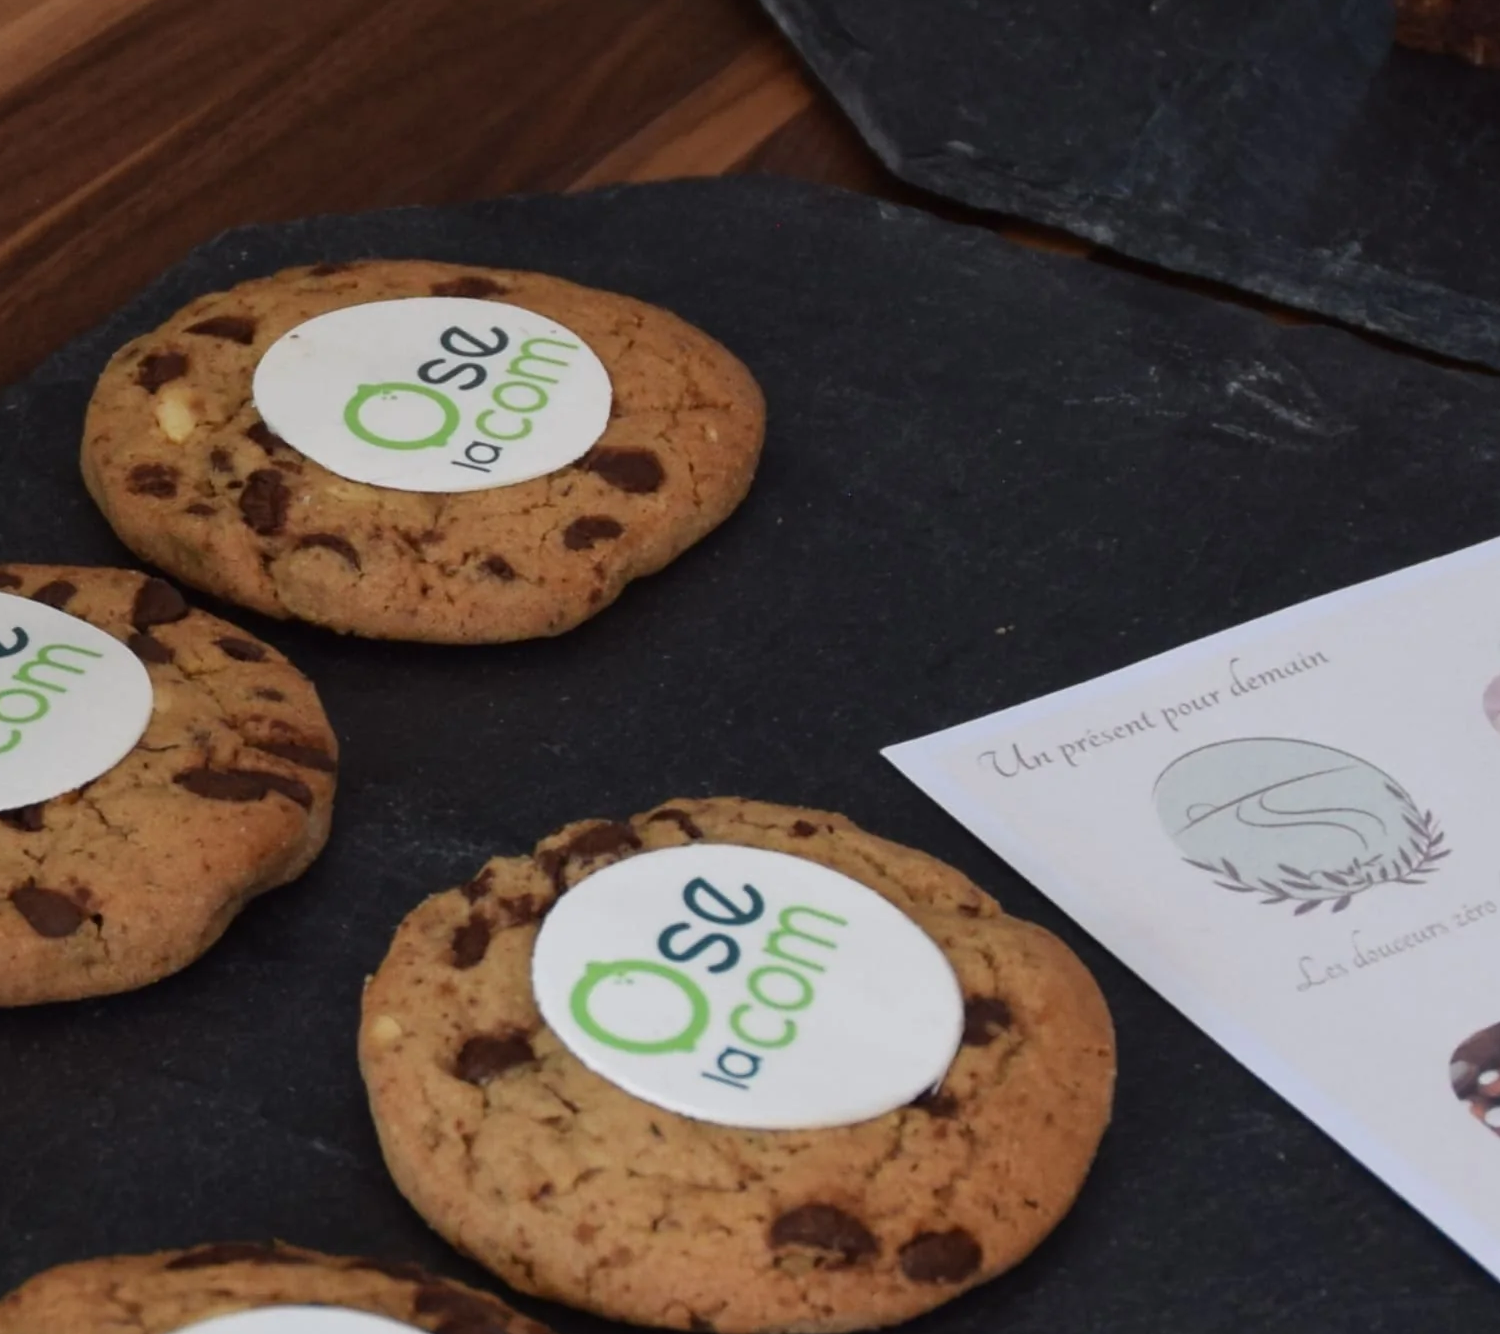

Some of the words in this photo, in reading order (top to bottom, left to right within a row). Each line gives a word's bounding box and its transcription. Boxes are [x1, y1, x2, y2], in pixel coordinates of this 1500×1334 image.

[343, 325, 510, 452] Ose
[978, 742, 1054, 778] Un
[1058, 711, 1157, 767] présent
[1160, 689, 1221, 732] pour
[1228, 650, 1330, 699] demain
[568, 876, 766, 1057] Ose
[1295, 955, 1349, 993] Les
[1351, 929, 1451, 970] douceurs
[1452, 901, 1498, 928] zéro
